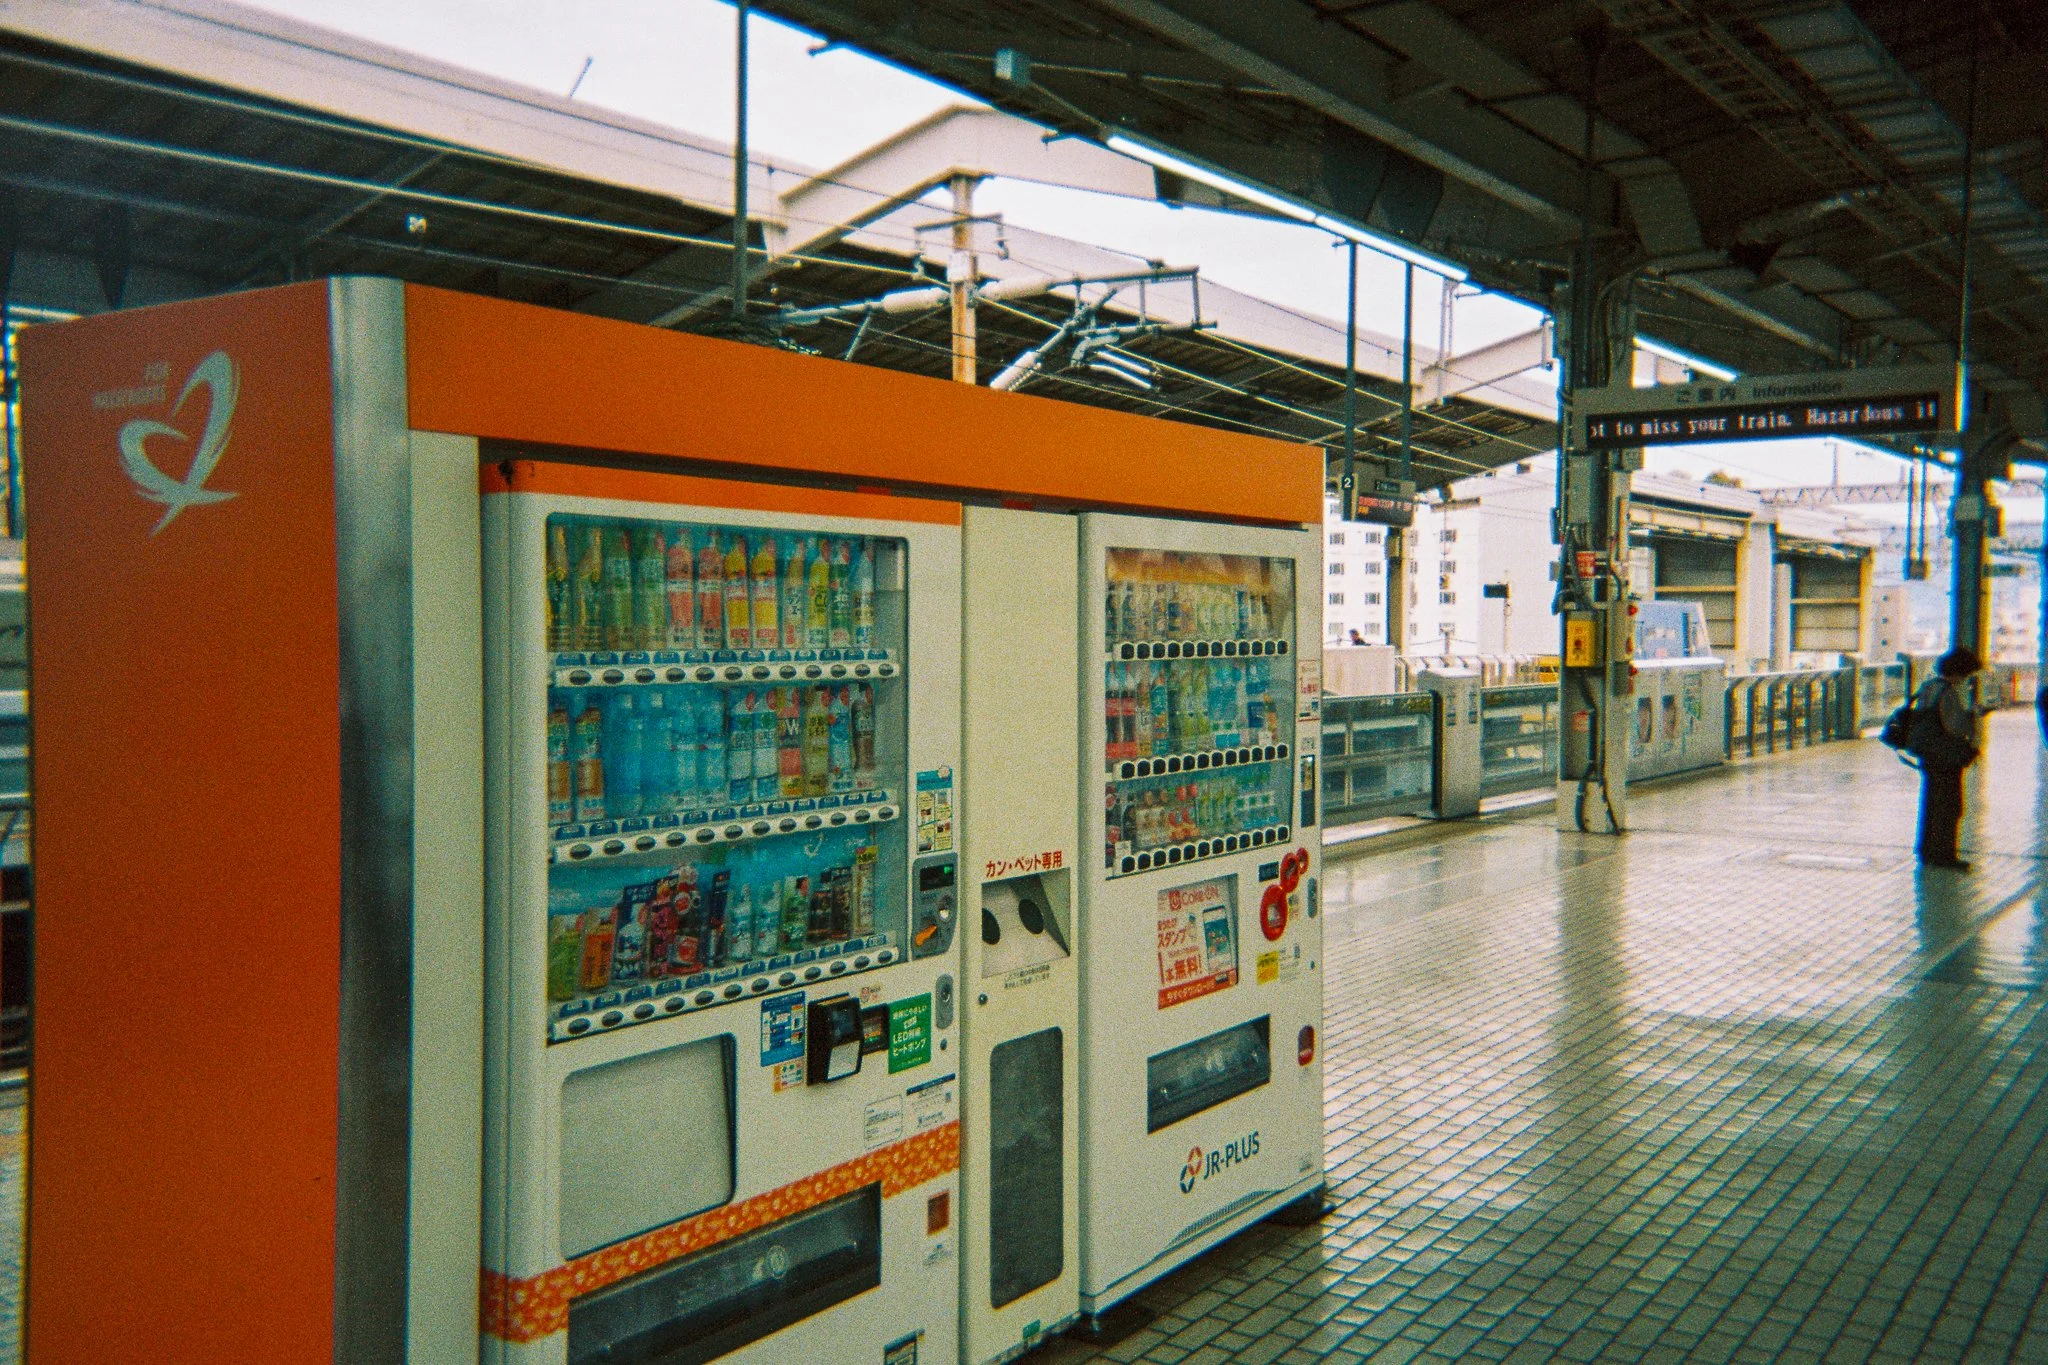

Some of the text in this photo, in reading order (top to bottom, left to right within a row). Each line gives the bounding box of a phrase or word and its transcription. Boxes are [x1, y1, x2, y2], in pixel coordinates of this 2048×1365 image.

[1753, 383, 1842, 398] Information
[1616, 422, 1633, 436] to
[1640, 418, 1679, 435] miss
[1688, 417, 1727, 434] your
[1738, 410, 1792, 430] train.
[1806, 404, 1903, 426] Hazardous
[1343, 477, 1352, 488] 2
[1203, 1129, 1260, 1180] JR-PLUS
